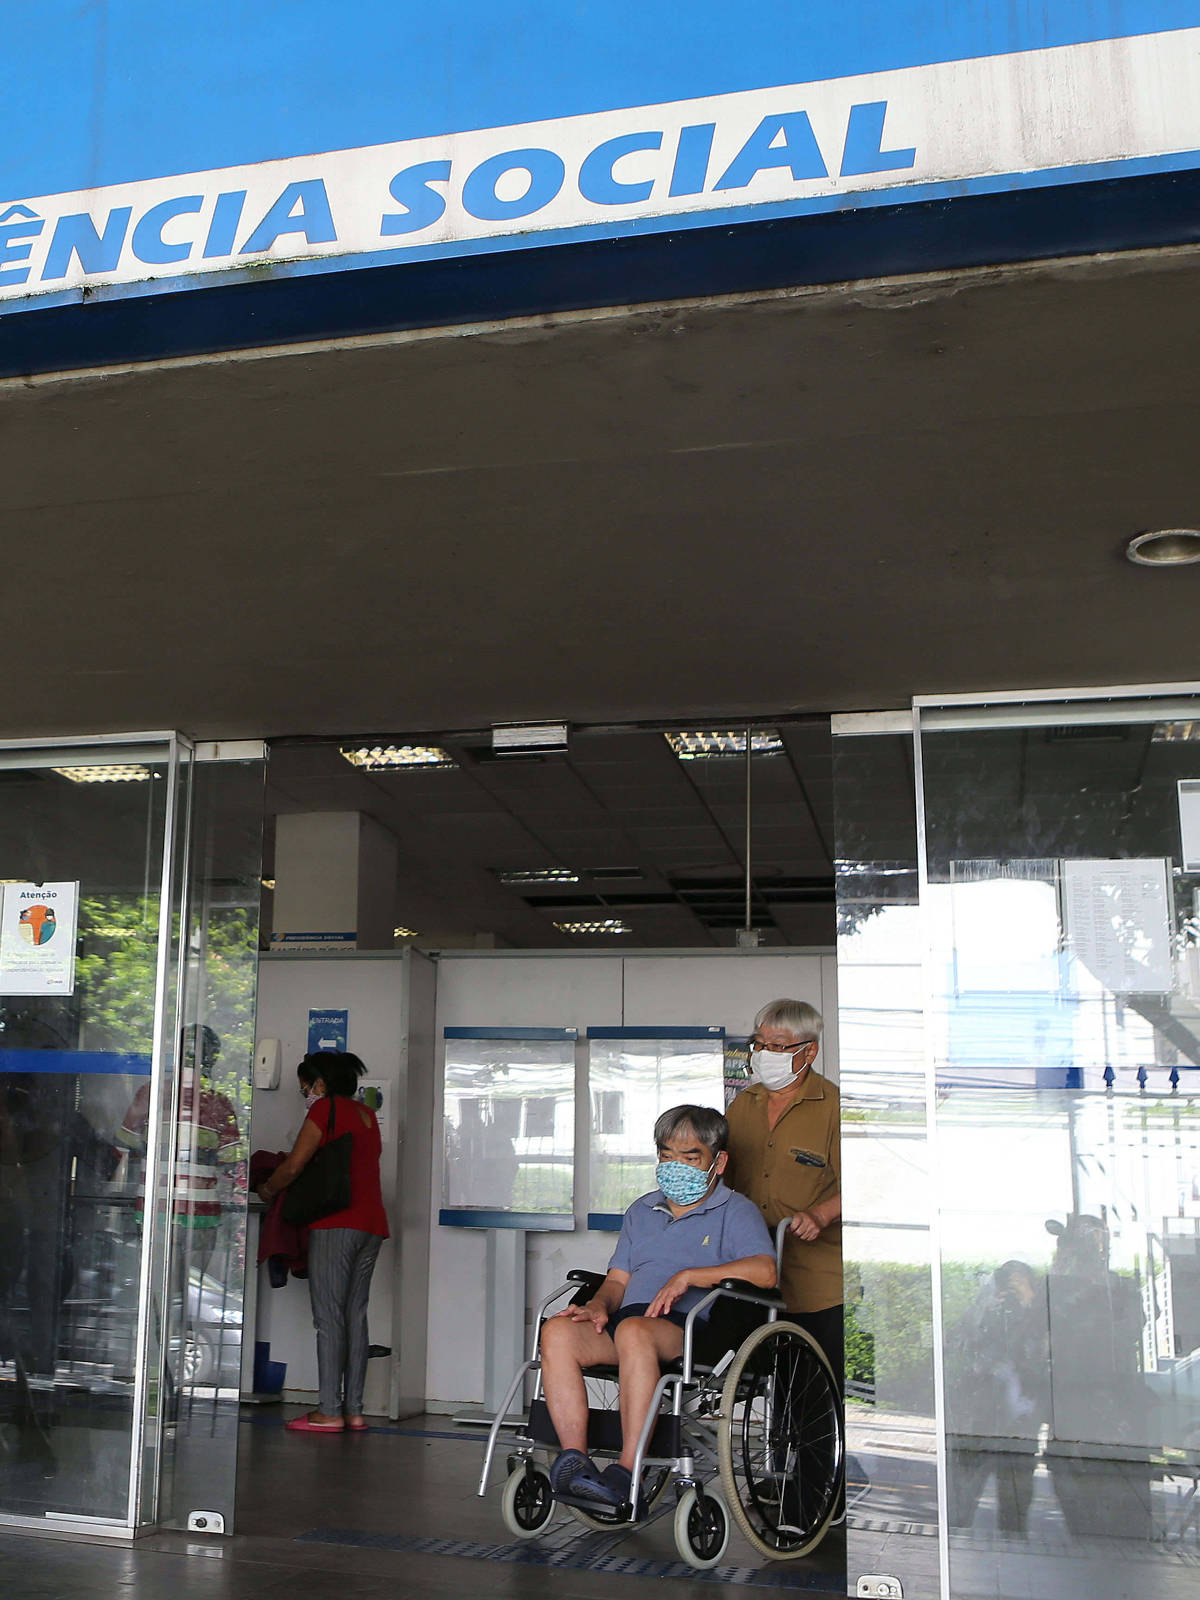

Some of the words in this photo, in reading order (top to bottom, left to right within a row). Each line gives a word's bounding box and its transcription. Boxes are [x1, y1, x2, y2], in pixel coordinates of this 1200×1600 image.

[380, 101, 917, 237] SOCIAL
[20, 890, 58, 900] Atenção
[311, 1016, 345, 1025] ENTRADA
